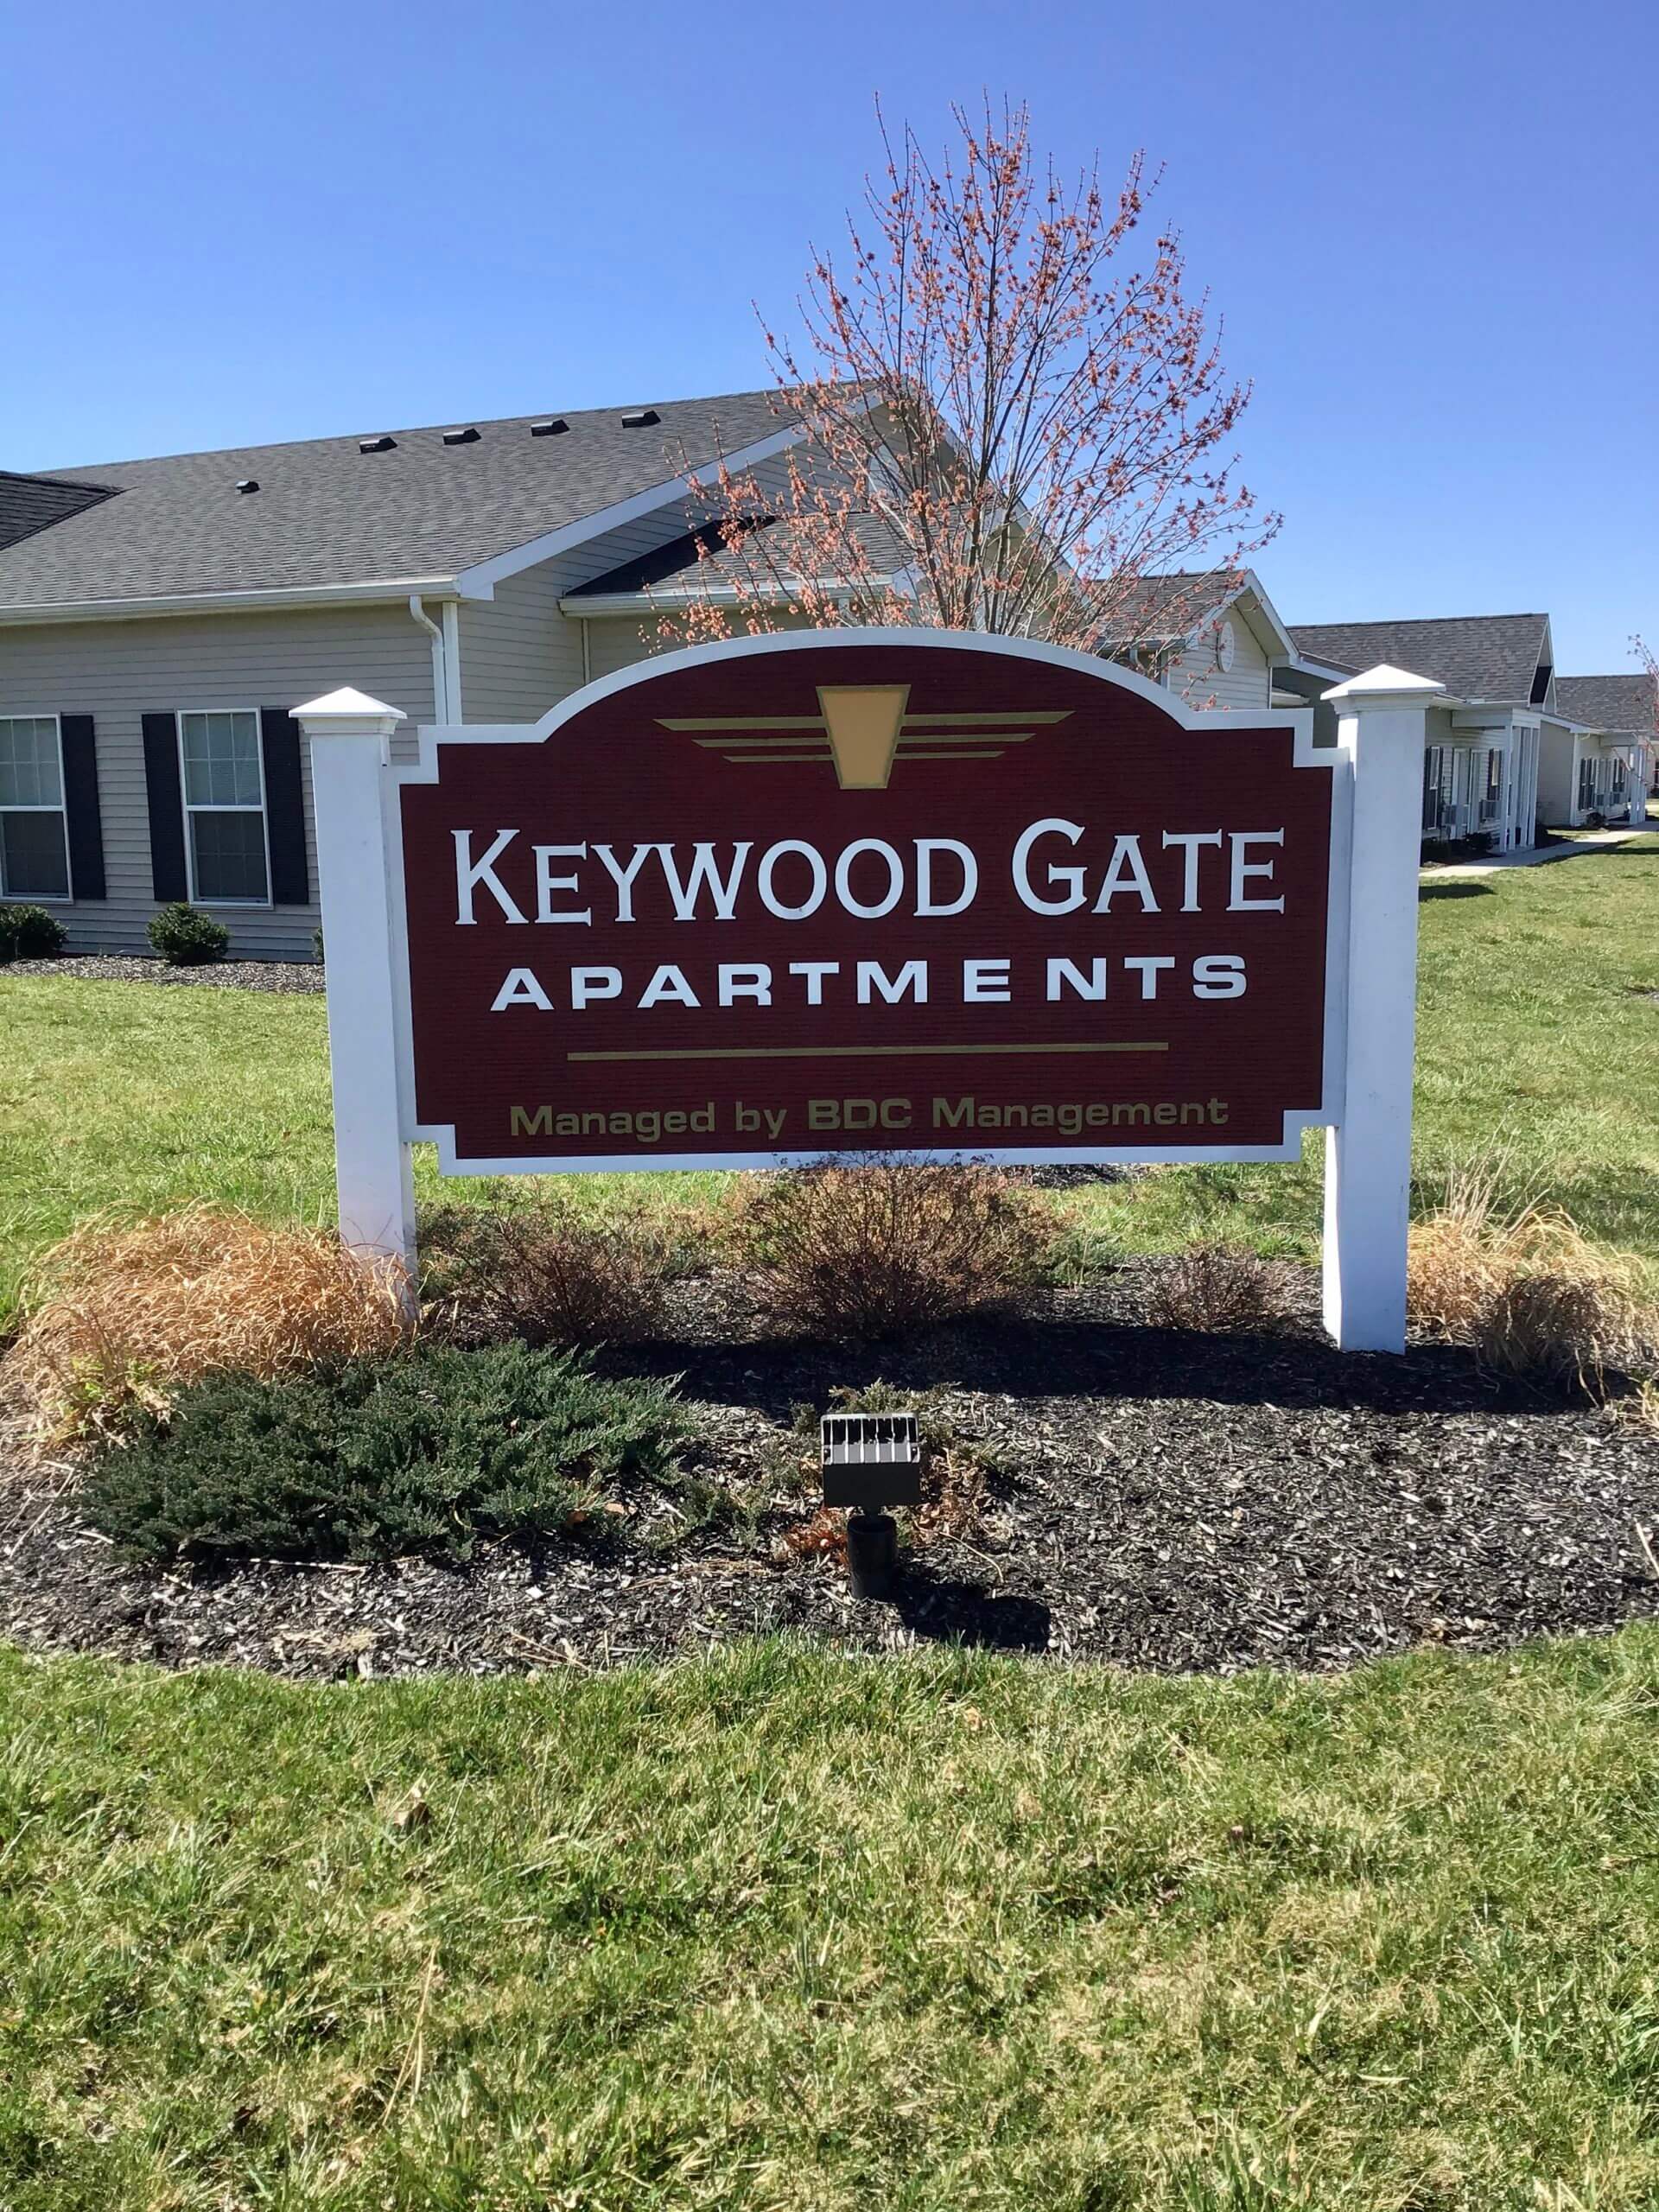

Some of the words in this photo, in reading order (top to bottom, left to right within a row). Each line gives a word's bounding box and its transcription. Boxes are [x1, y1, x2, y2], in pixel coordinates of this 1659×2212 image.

[451, 830, 978, 926] KEYWOOD
[1013, 818, 1285, 916] GATE
[491, 956, 1247, 1010] APARTMENTS
[512, 1103, 715, 1141] Managed
[736, 1102, 787, 1139] by
[809, 1098, 912, 1129] BDC
[933, 1097, 1228, 1135] Management
